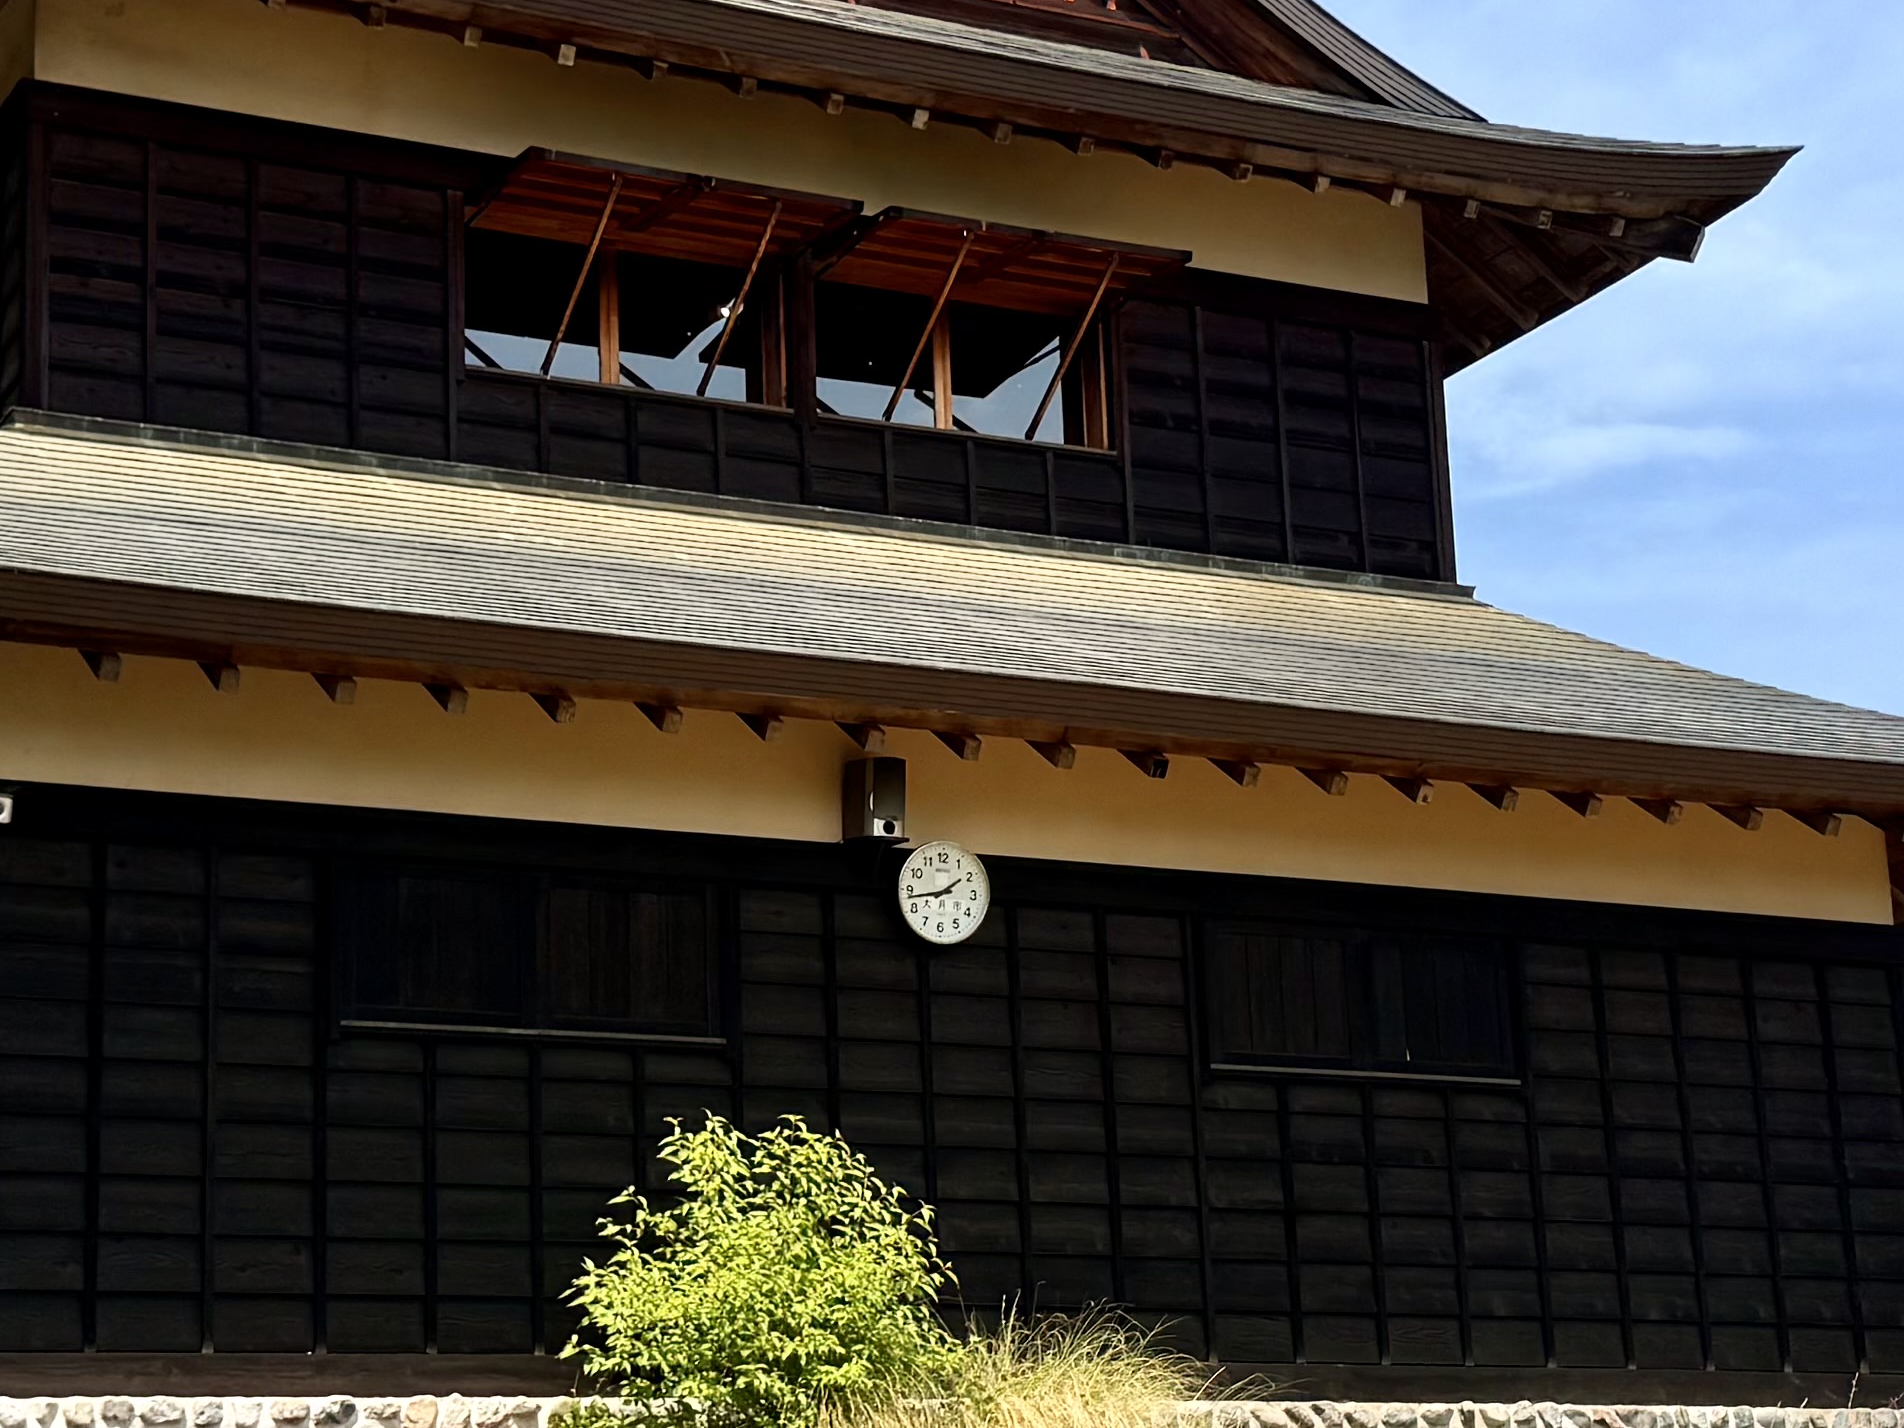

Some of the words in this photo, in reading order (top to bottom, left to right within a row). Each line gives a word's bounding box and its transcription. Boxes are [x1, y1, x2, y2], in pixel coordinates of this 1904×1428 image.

[923, 856, 933, 867] 11
[937, 852, 949, 864] 12
[910, 867, 923, 879] 10
[966, 871, 973, 882] 2
[906, 884, 914, 897] 9
[969, 890, 977, 901] 3
[910, 902, 918, 914] 8
[963, 907, 971, 918] 4
[922, 916, 929, 927] 7
[936, 921, 944, 933] 6
[952, 918, 960, 929] 5
